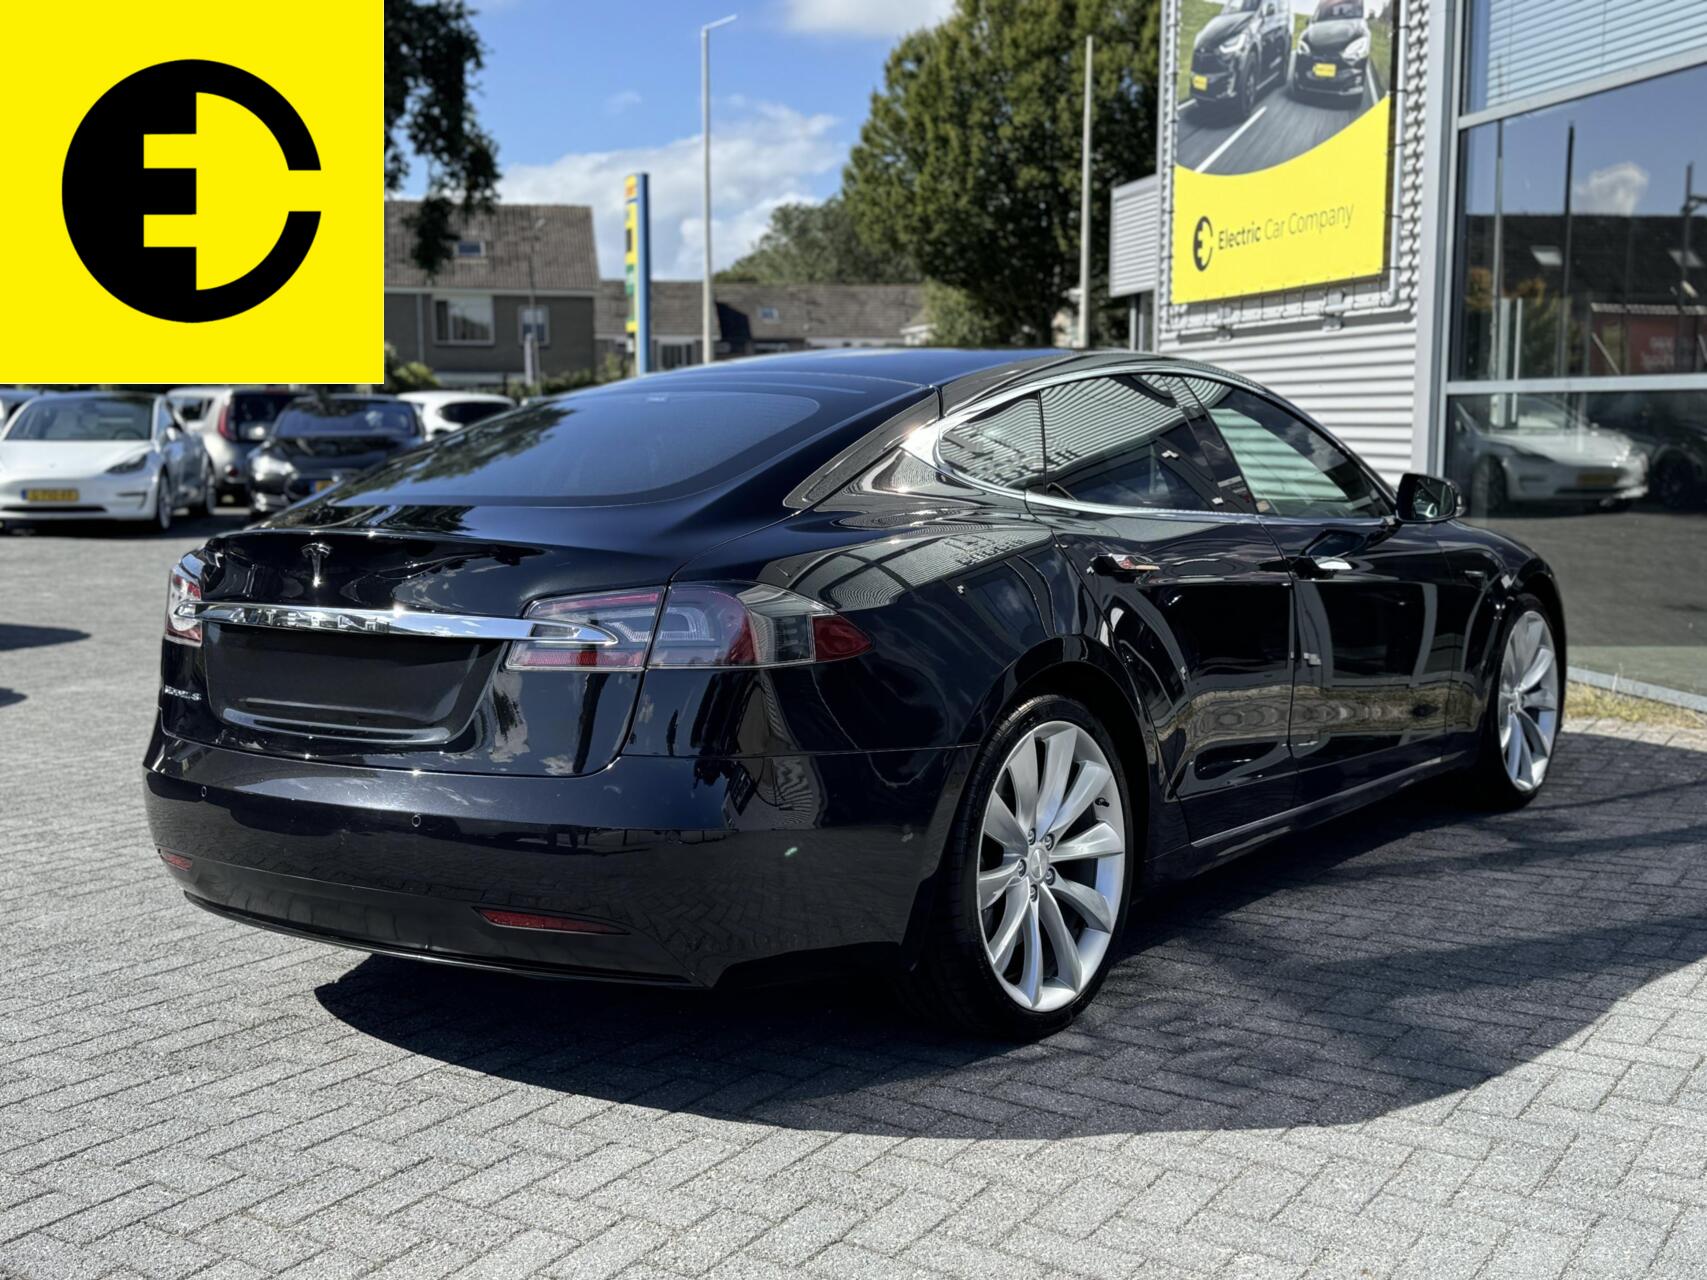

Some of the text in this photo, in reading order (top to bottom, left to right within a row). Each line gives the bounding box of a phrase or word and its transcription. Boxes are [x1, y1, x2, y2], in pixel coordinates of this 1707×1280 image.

[1218, 203, 1354, 250] Electric Car Company
